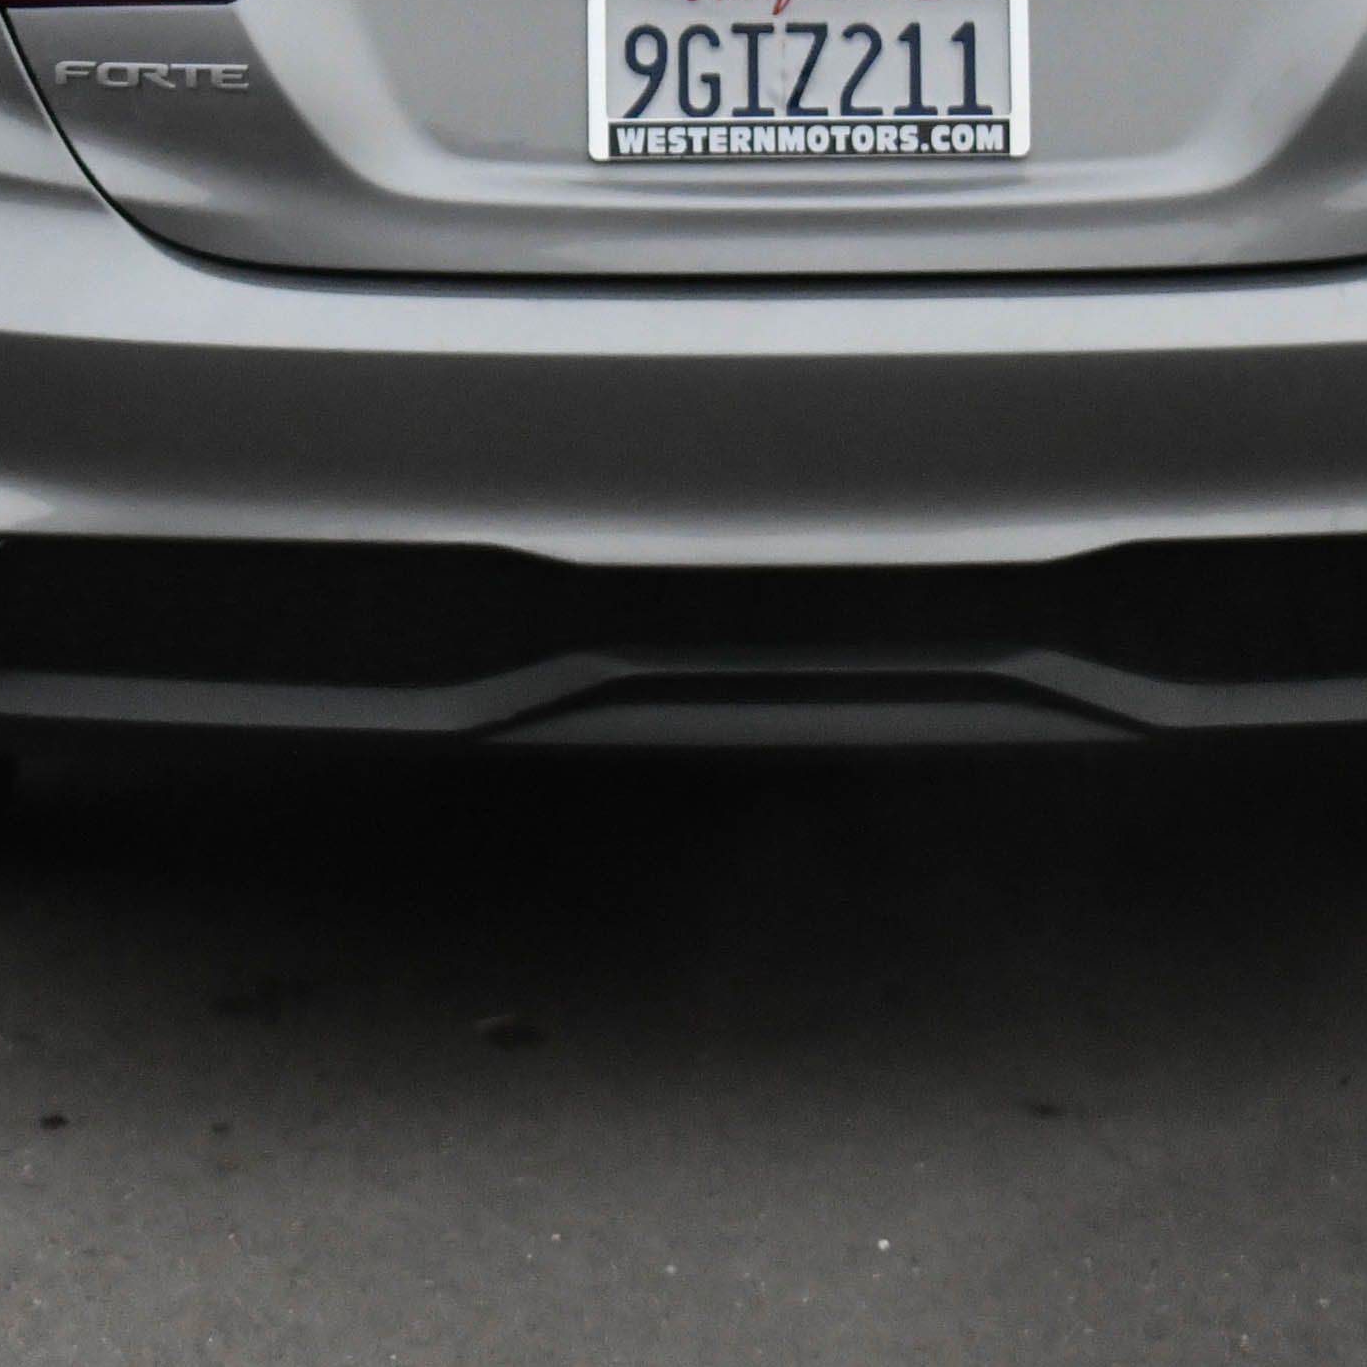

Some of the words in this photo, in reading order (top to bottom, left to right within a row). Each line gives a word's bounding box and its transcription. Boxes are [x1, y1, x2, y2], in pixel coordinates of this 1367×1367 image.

[55, 60, 249, 89] FORTE
[623, 20, 993, 119] 9GIZ211
[616, 125, 1004, 154] WESTERNMOTORS.COM
